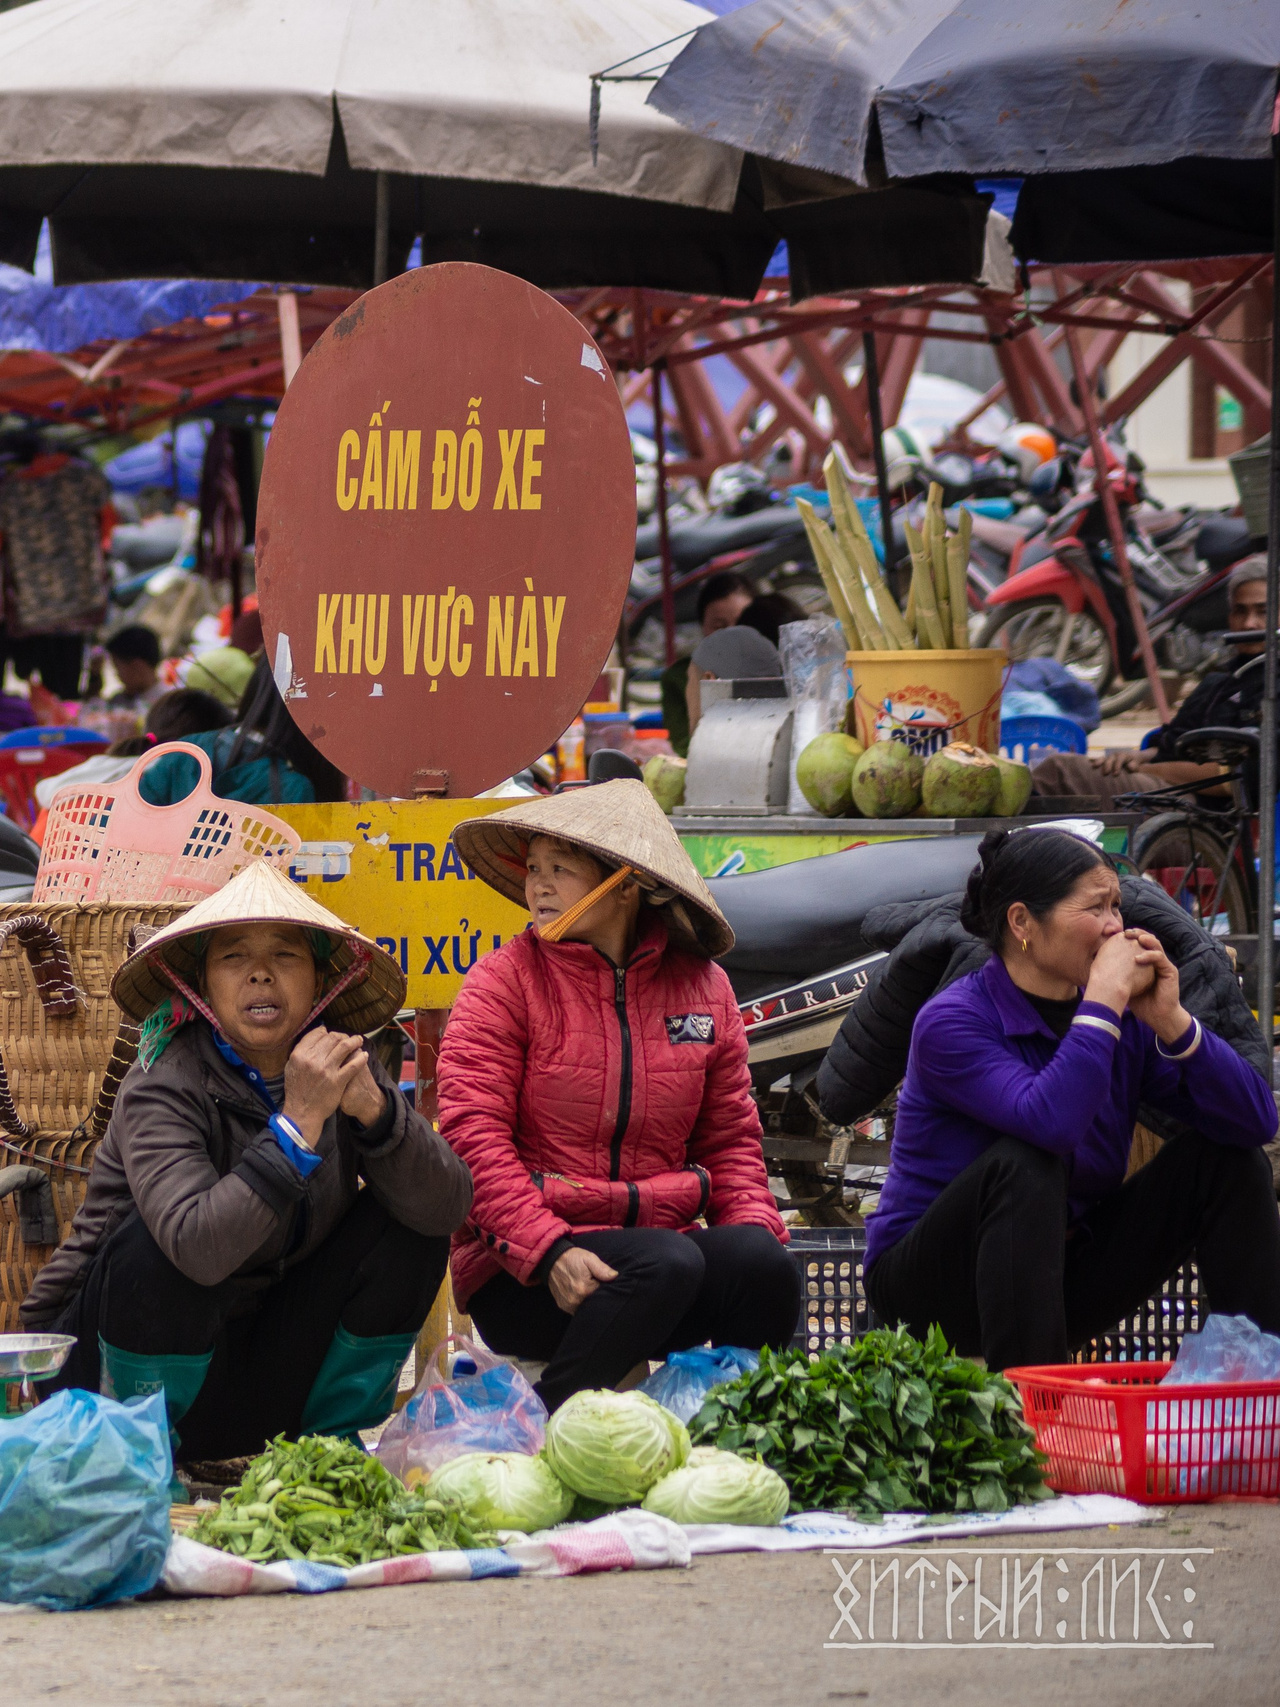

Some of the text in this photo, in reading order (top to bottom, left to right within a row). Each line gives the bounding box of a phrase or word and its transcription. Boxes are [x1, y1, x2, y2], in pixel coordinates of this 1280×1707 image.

[335, 396, 546, 512] CẤM ĐỖ XE
[314, 577, 567, 692] KHU VỰC NÀY
[388, 831, 477, 882] TRÁ
[422, 918, 482, 975] XỬ
[751, 969, 869, 1023] SIRIU
